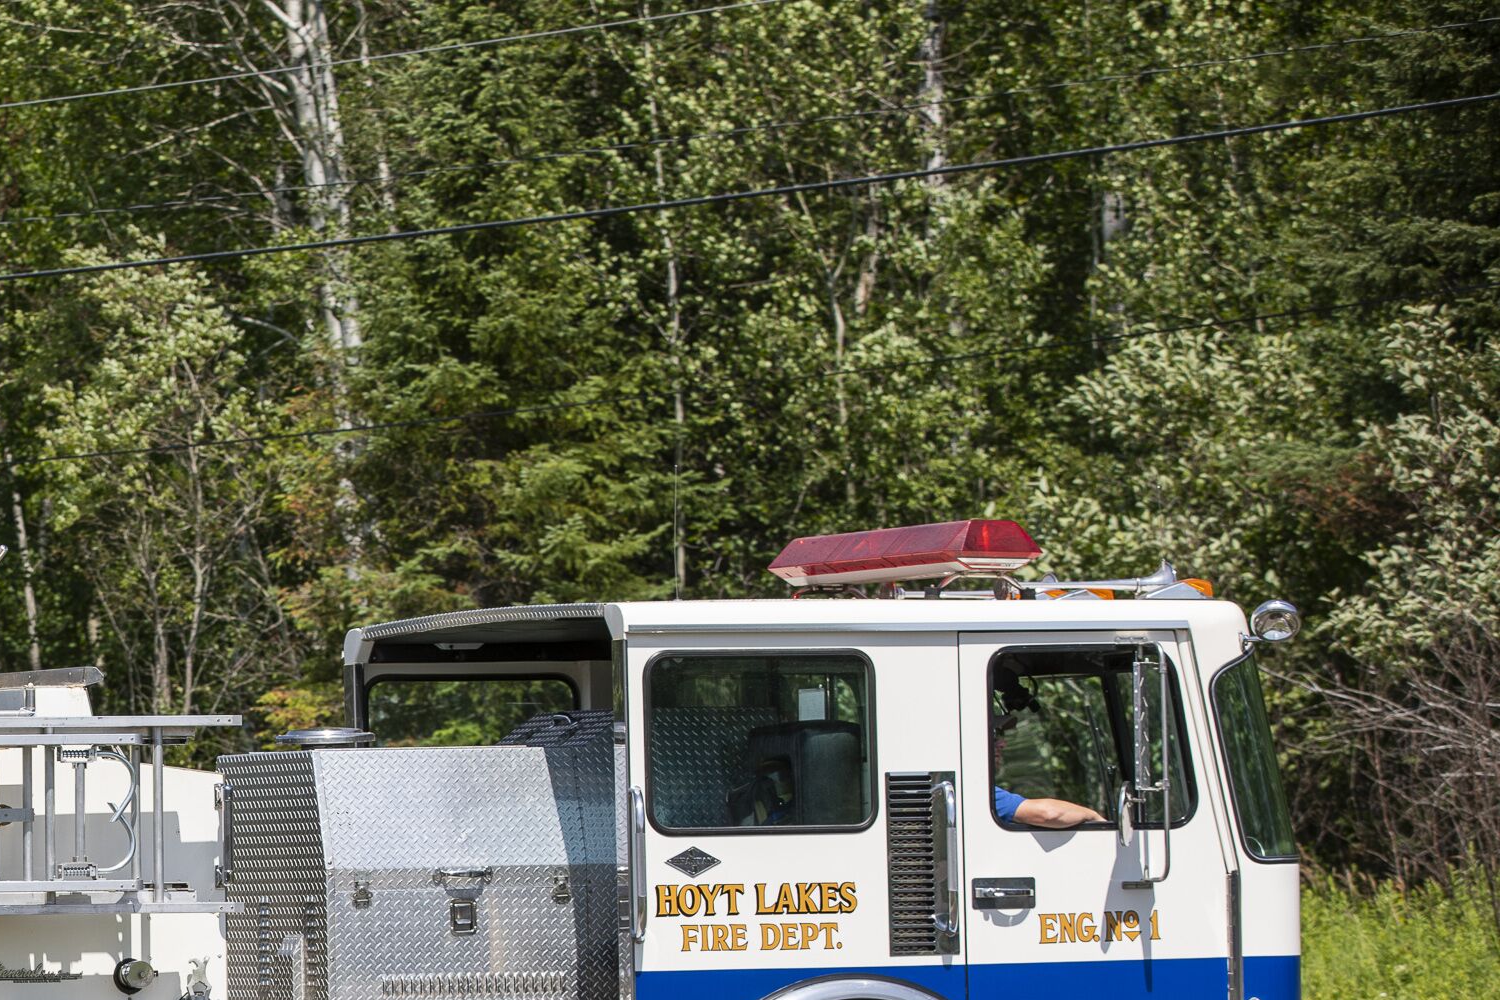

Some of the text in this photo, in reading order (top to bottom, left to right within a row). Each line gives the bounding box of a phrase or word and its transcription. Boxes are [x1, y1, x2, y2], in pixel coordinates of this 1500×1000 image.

[655, 882, 858, 918] HOYT LAKES
[680, 922, 843, 952] FIRE DEPT.
[1038, 912, 1100, 944] ENG.
[1148, 909, 1162, 941] 1
